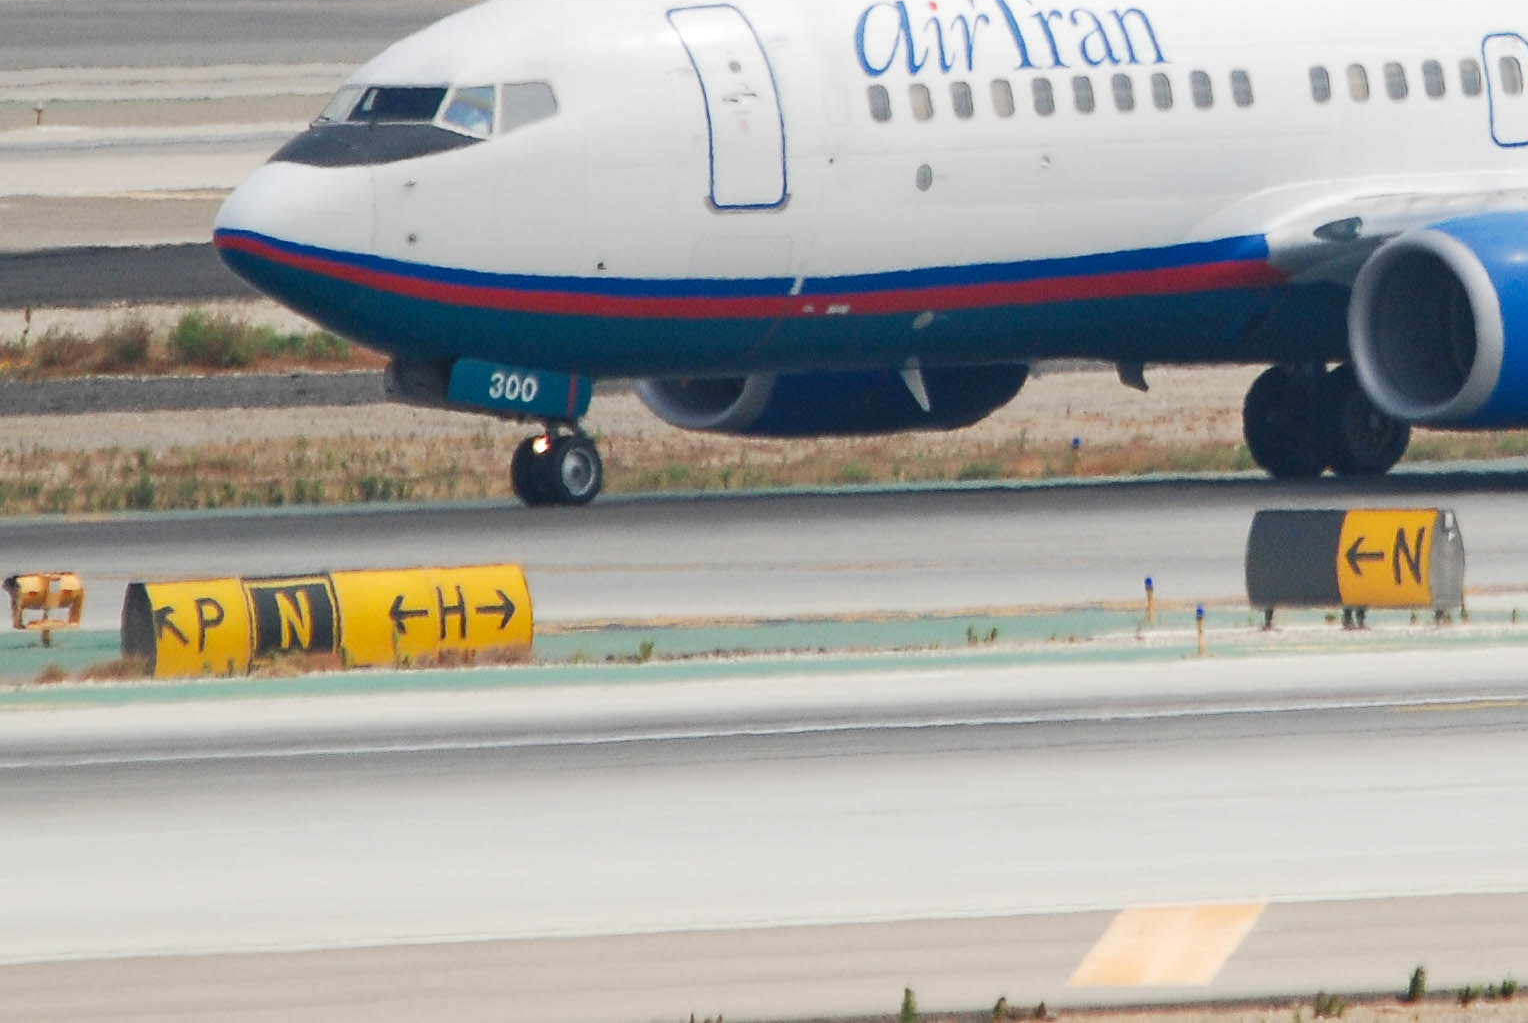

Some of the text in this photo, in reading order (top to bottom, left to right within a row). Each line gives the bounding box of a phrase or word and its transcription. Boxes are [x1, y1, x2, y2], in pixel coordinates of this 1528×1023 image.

[489, 372, 538, 403] 300
[1393, 526, 1425, 586] N
[195, 585, 467, 652] P N H
